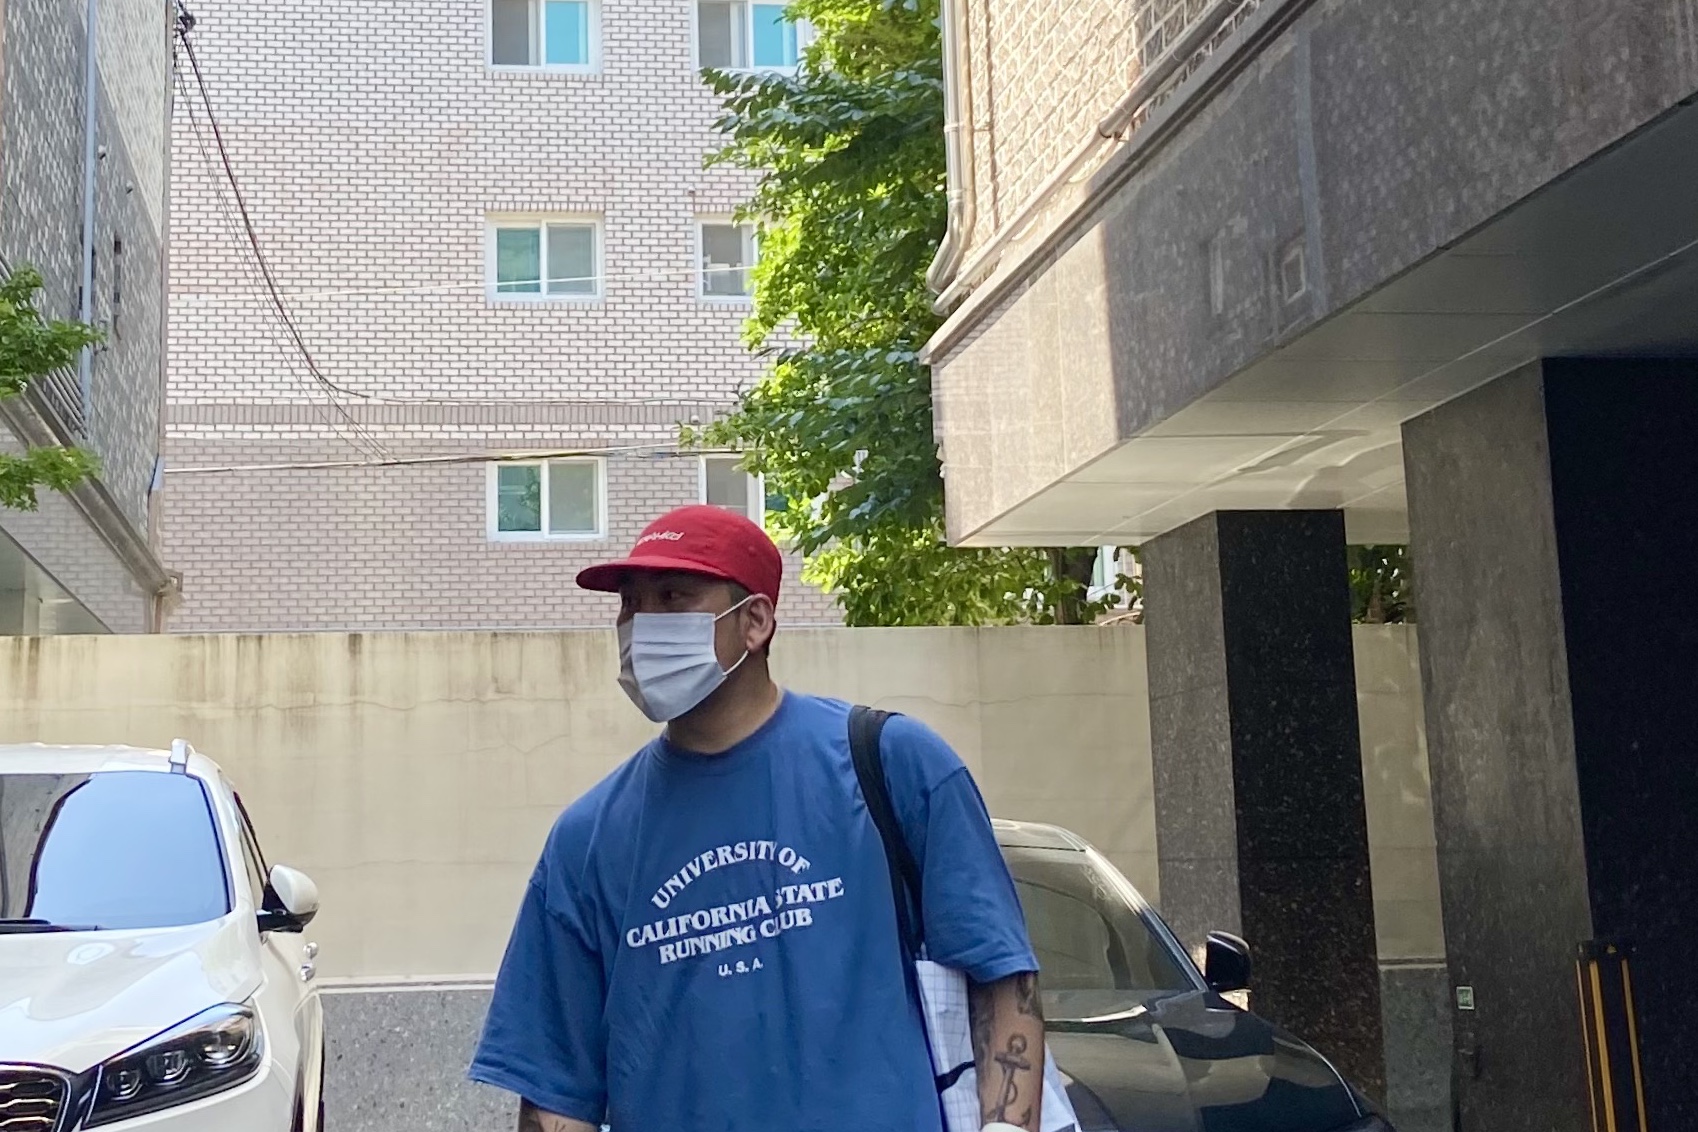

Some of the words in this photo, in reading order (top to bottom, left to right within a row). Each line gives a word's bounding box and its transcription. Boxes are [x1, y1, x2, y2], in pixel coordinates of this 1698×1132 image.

[652, 840, 777, 909] UNIVERSITY
[778, 847, 811, 874] OF
[626, 896, 771, 948] CALIFORNIA
[659, 925, 756, 964] RUNNING
[760, 908, 813, 939] CLUB
